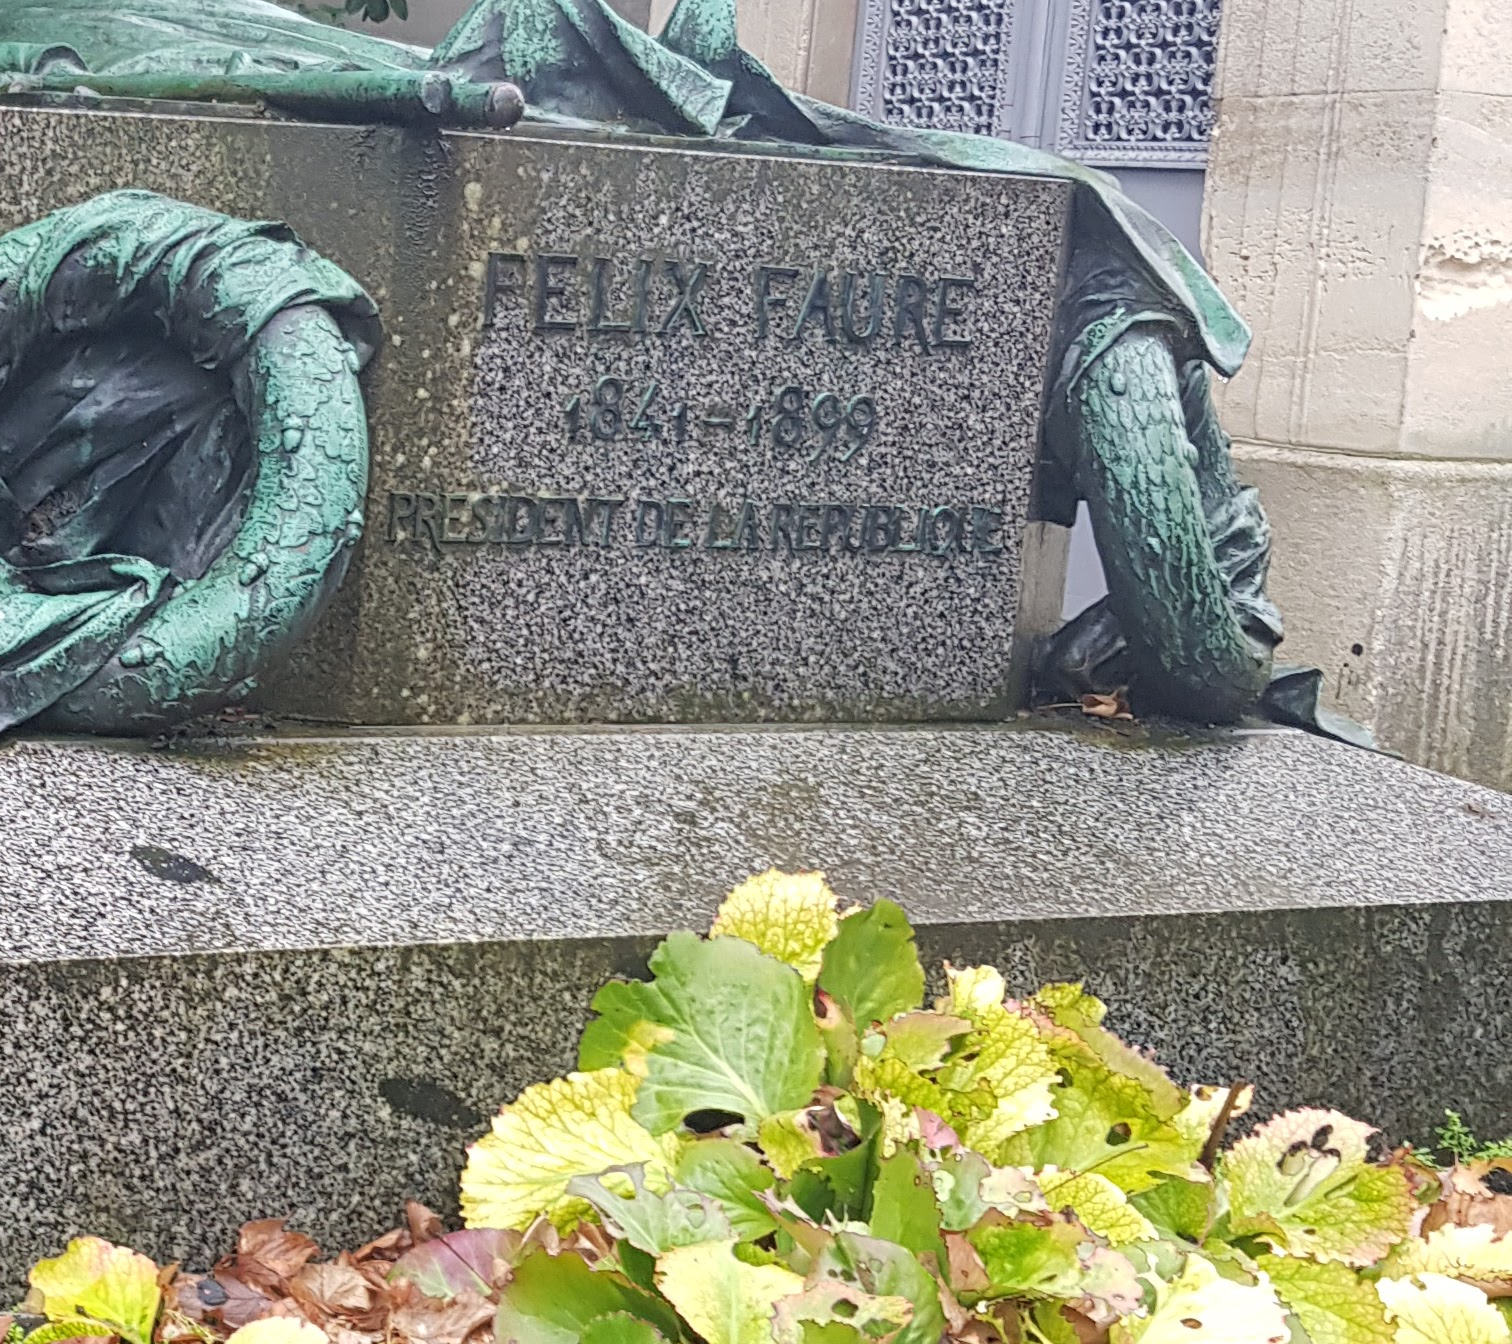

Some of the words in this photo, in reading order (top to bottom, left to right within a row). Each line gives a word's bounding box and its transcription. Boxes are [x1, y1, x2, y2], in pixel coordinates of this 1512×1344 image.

[482, 251, 712, 337] FELIX
[753, 264, 976, 356] FAURE
[384, 491, 627, 554] PRESIDENT
[636, 497, 692, 549] DE
[705, 499, 759, 550] LA
[769, 503, 1004, 556] REPUBLIQUE
